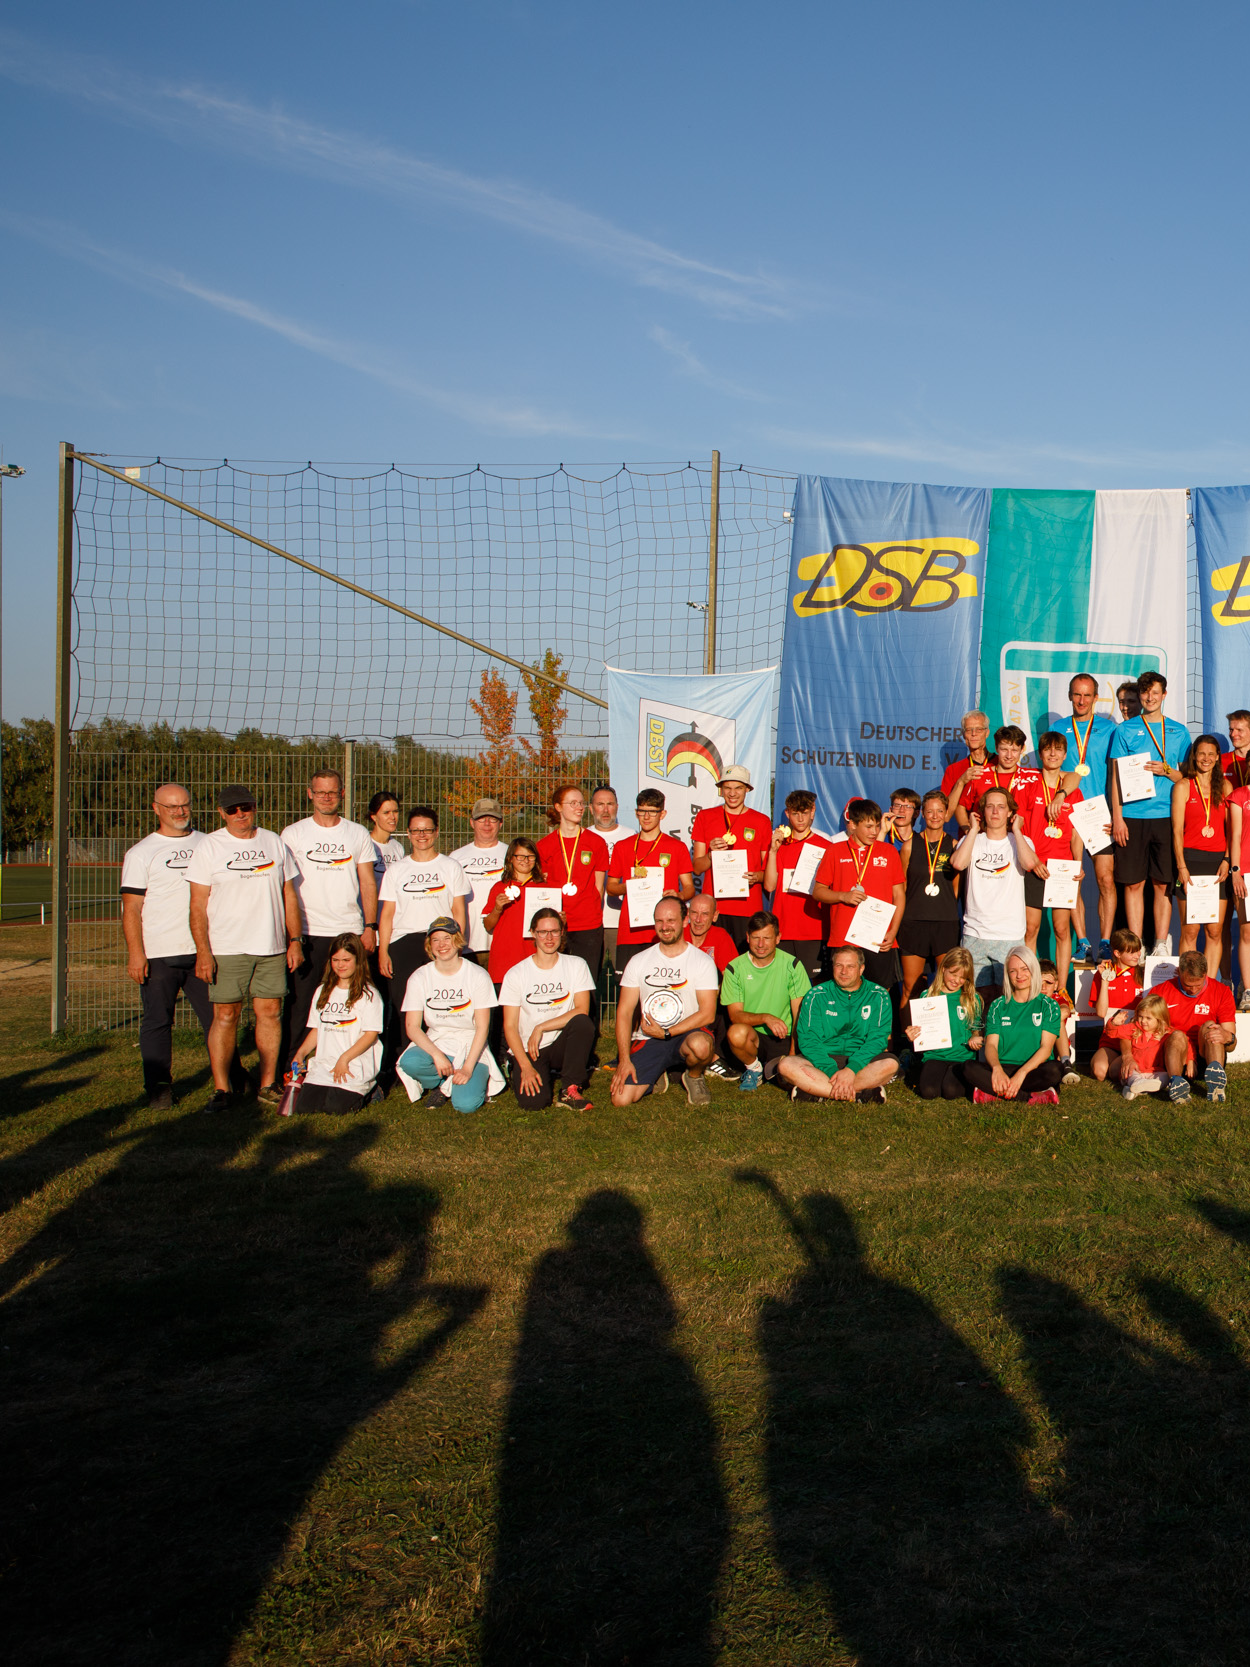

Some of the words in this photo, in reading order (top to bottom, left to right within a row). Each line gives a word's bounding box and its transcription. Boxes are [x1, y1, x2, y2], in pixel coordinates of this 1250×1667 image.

[799, 543, 967, 613] DSB
[860, 721, 963, 743] DEUTSCHER
[649, 717, 665, 777] DBSV
[781, 746, 916, 770] SCHÜTZENBUND
[922, 755, 937, 771] E.
[315, 843, 345, 854] 2024
[171, 849, 194, 861] 202
[233, 850, 266, 862] 2024
[982, 852, 1004, 863] 2024
[470, 857, 498, 867] 2024
[240, 872, 271, 880] Bogenlaufen
[410, 873, 439, 884] 2024
[652, 967, 681, 978] 2024
[533, 982, 563, 995] 2024
[433, 989, 463, 1000] 2024
